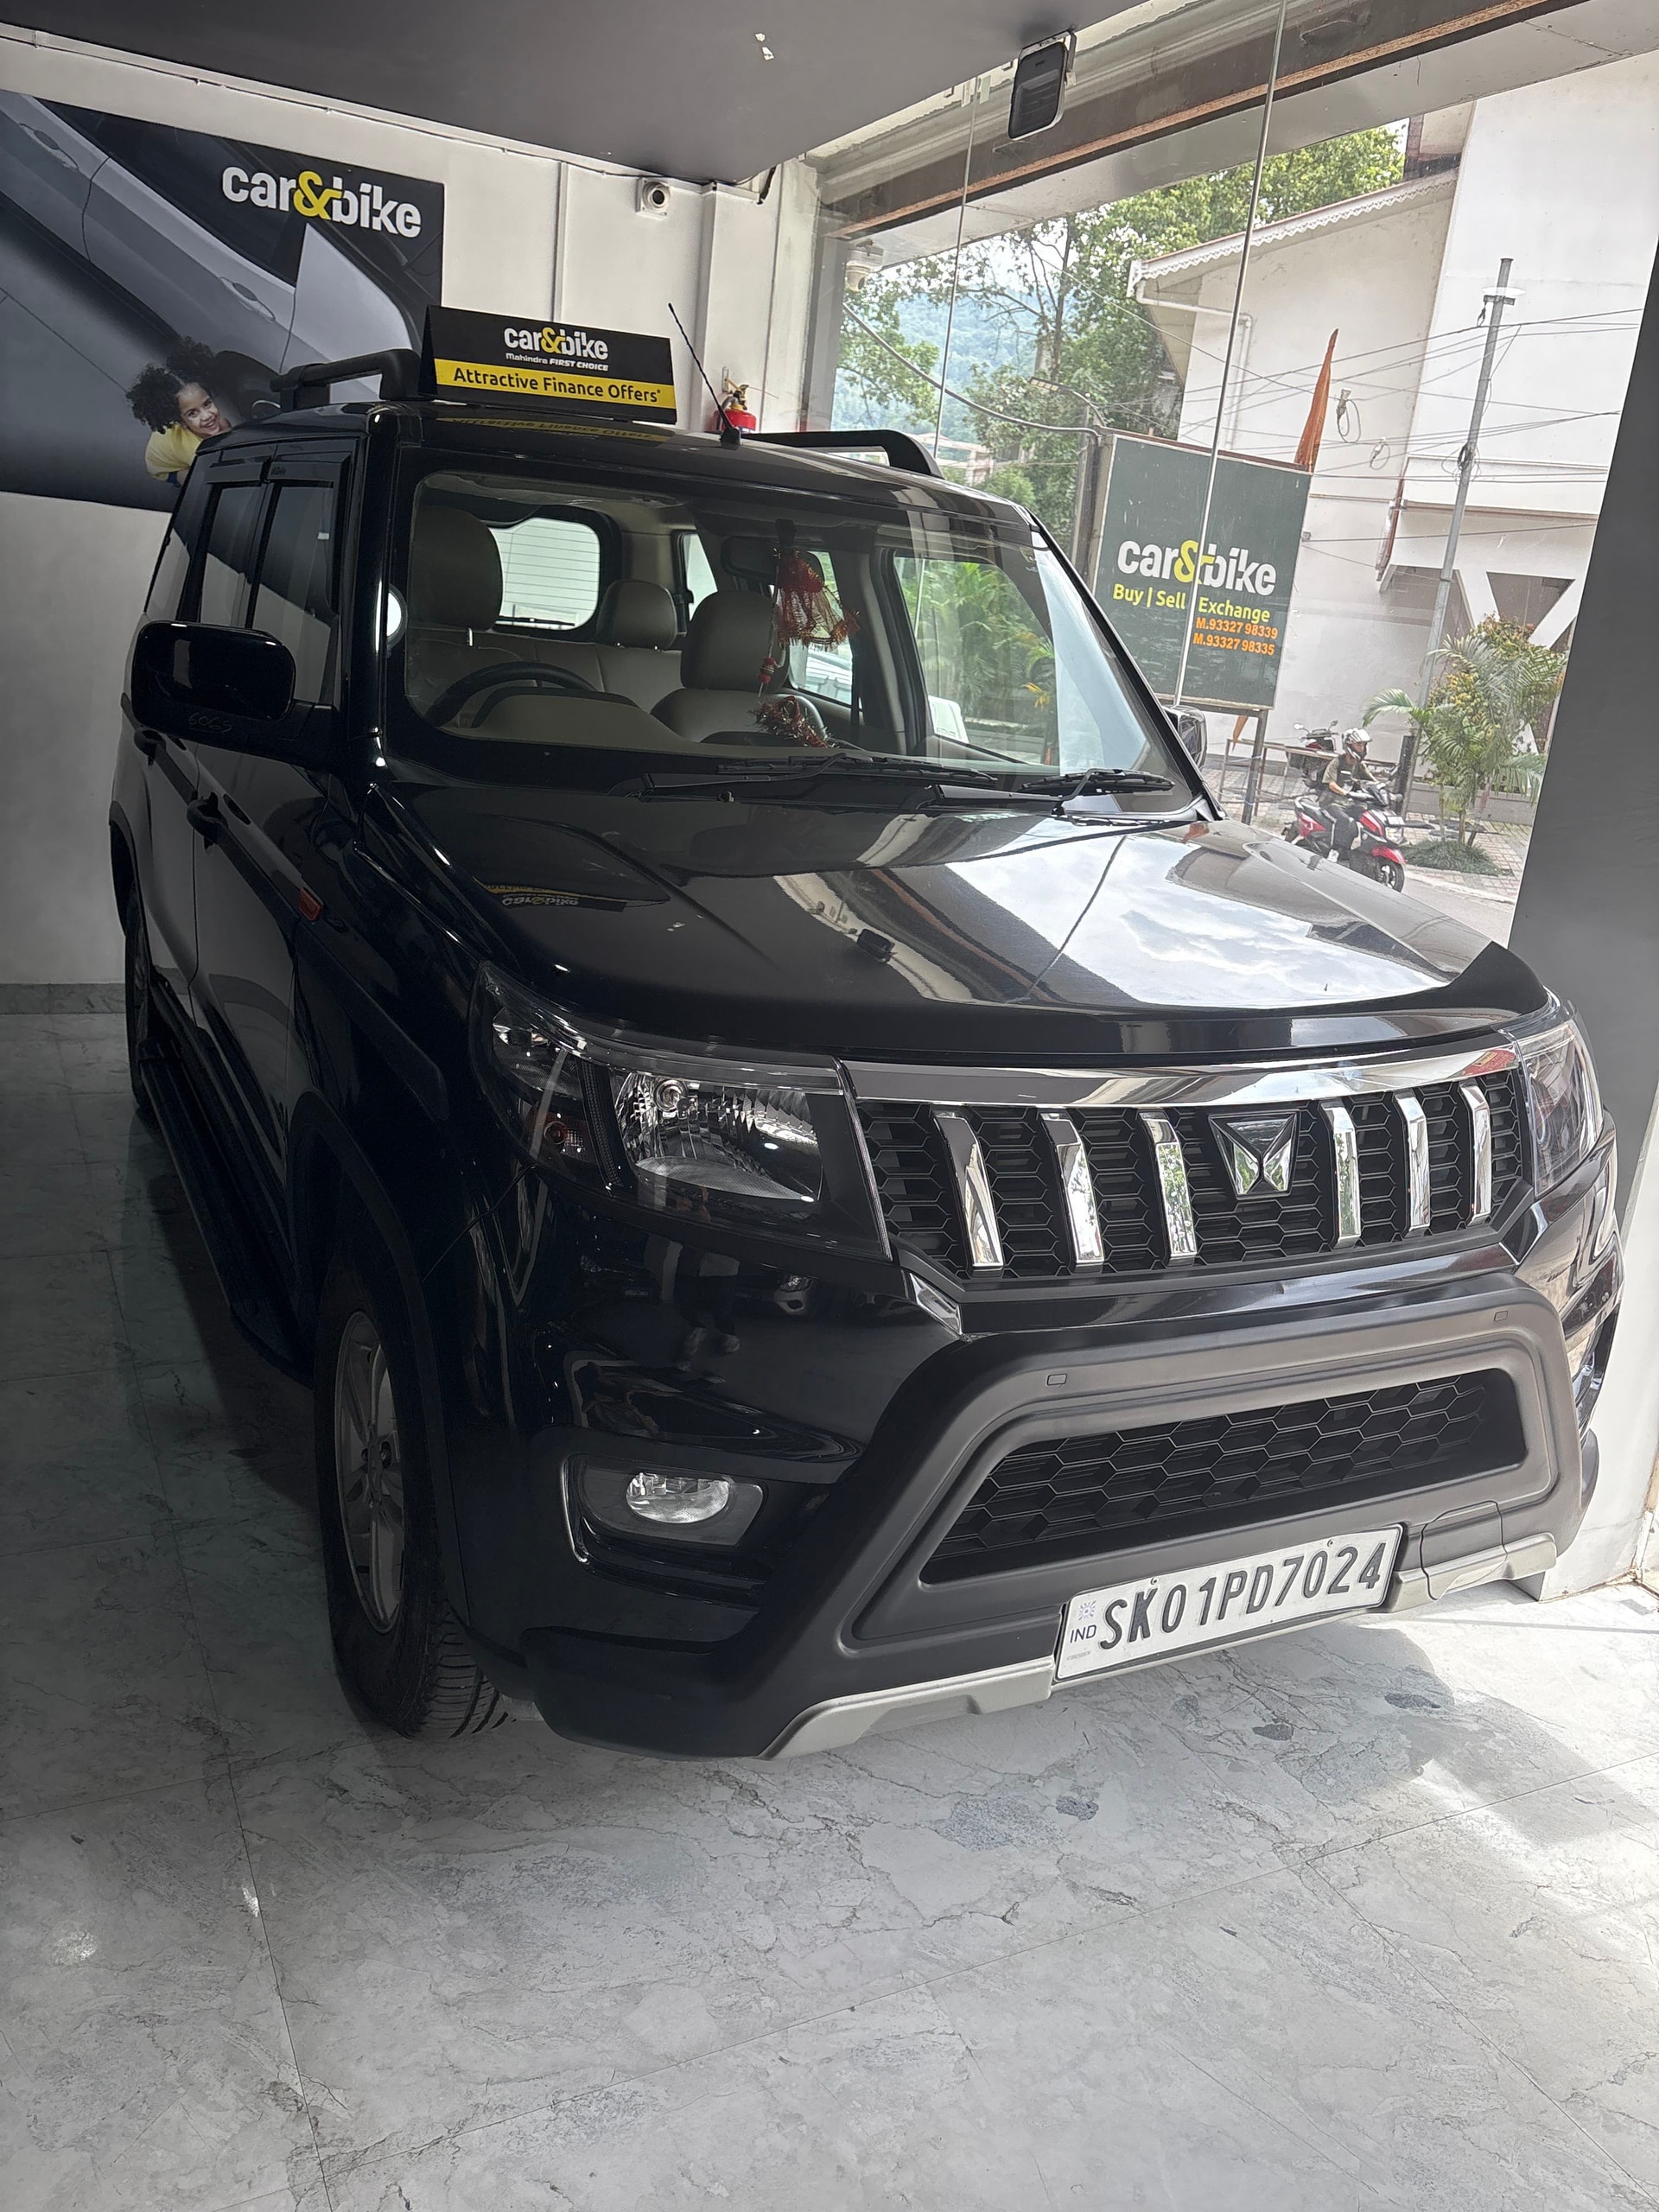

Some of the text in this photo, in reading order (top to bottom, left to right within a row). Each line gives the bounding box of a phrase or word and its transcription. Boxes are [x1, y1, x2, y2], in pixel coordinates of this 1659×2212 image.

[221, 166, 423, 238] car&bike
[503, 327, 609, 360] car&bike
[505, 353, 609, 372] Mahindra FIRST CHOICE
[454, 367, 539, 391] Attractive
[543, 377, 604, 397] Finance
[1117, 539, 1277, 596] car&bike
[1112, 583, 1145, 607] Buy
[1155, 590, 1186, 610] Sell
[1198, 596, 1271, 624] Exchange
[1195, 617, 1279, 639] M.93327 98339
[1192, 632, 1275, 656] M.93327 98335
[1099, 1542, 1388, 1650] SK01PD7024
[1070, 1624, 1097, 1643] IND
